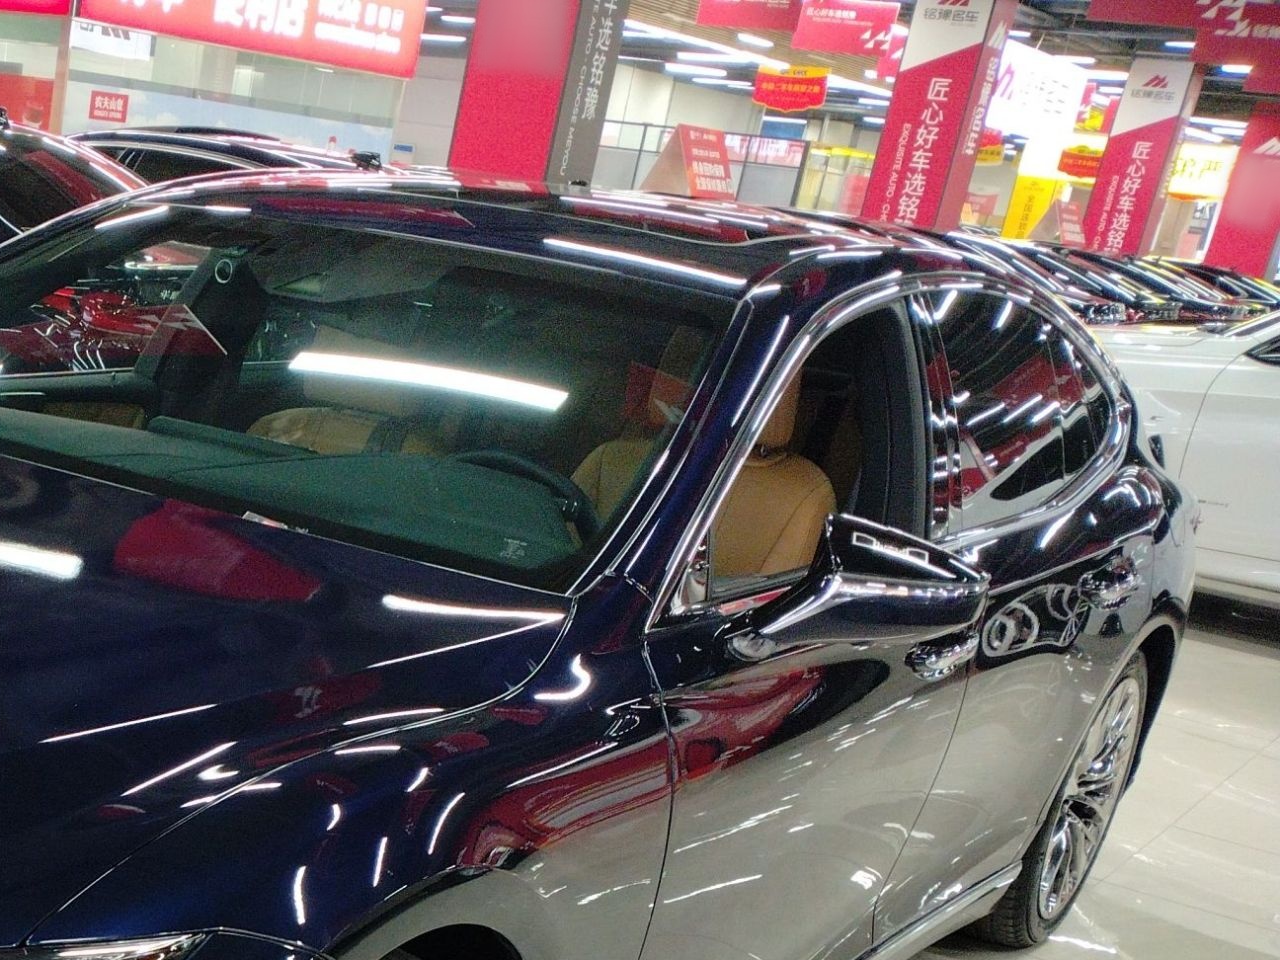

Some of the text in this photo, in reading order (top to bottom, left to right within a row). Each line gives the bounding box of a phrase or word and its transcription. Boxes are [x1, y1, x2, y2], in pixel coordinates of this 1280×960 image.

[894, 77, 953, 225] 匠心好车选铭
[1103, 141, 1153, 253] 匠心好车选铭
